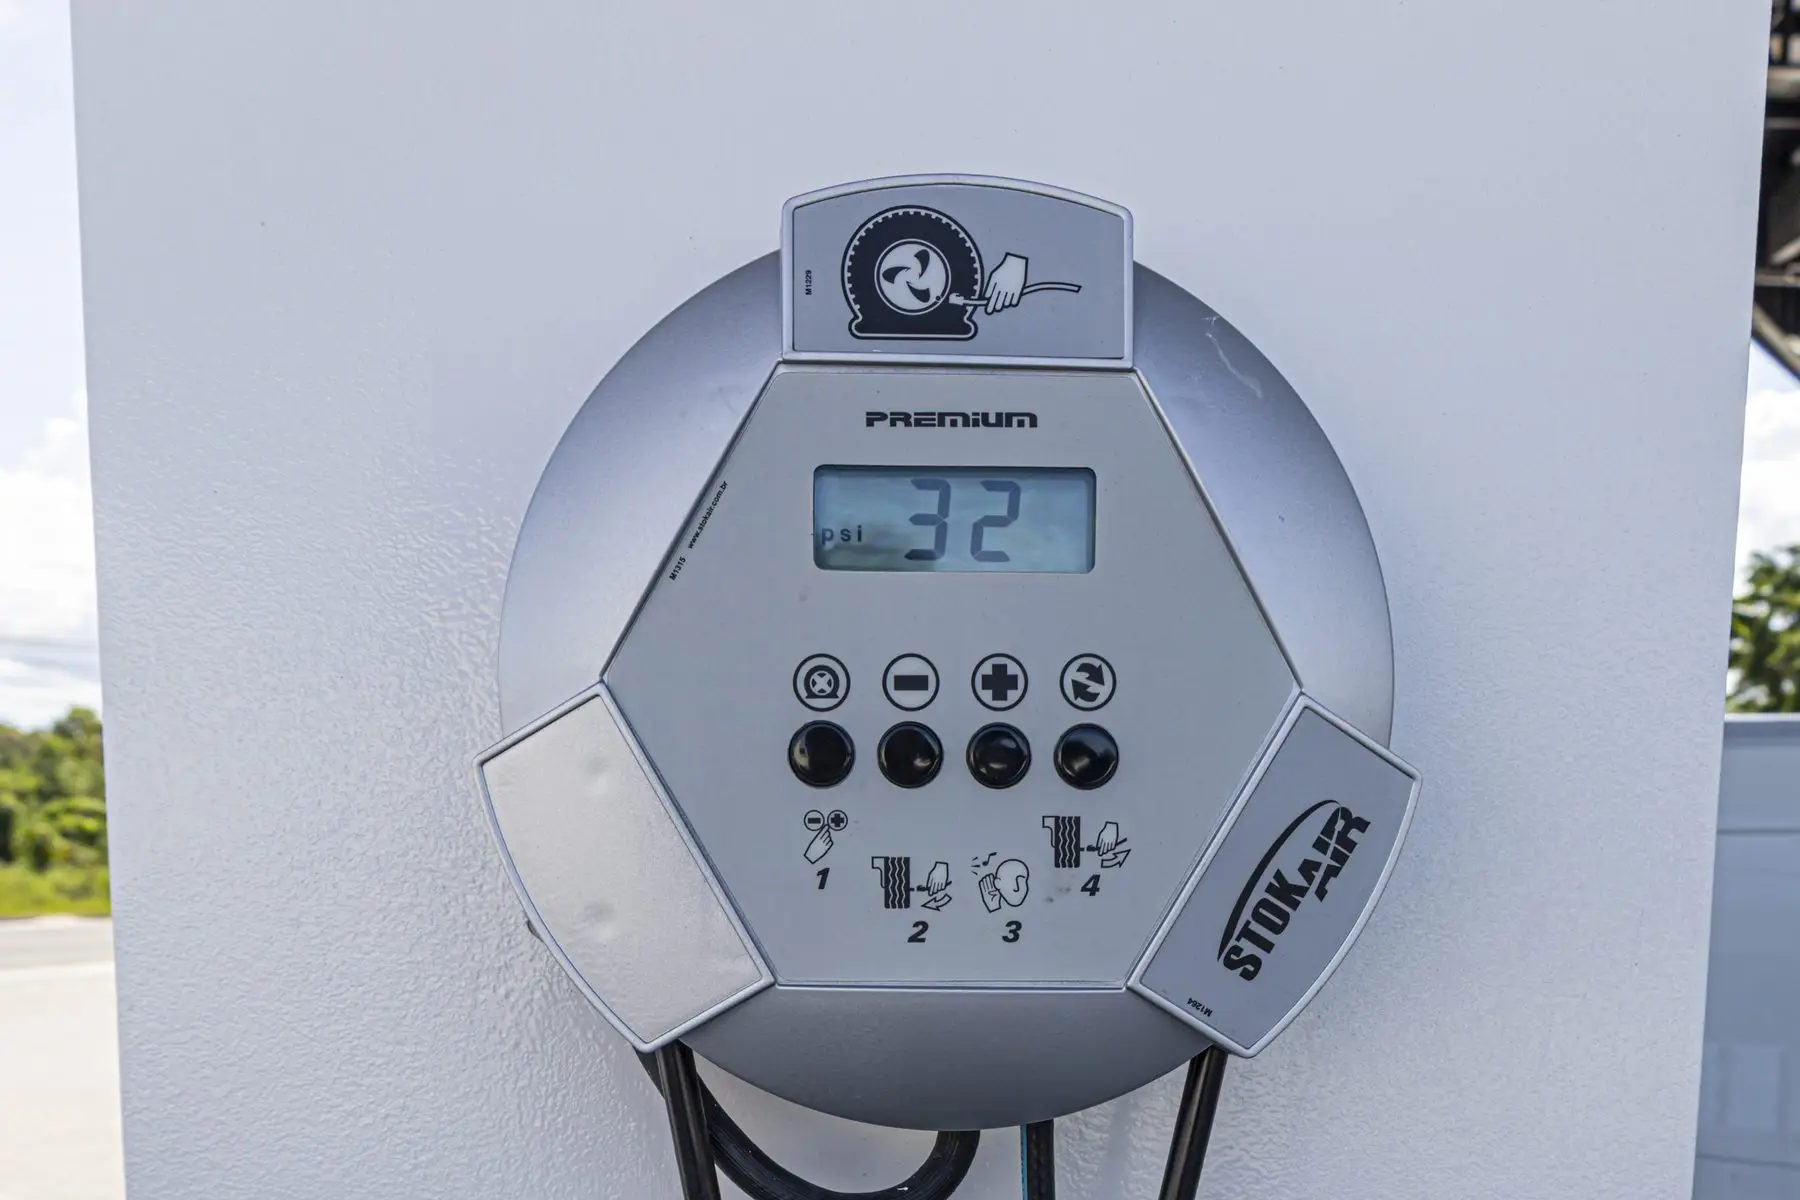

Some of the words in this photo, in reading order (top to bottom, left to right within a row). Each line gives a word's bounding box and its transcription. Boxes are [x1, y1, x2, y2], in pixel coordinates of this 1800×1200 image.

[669, 556, 686, 580] M1315
[688, 480, 728, 549] www.stokair.com.br
[904, 478, 1021, 562] 32
[821, 525, 863, 546] psi
[815, 868, 830, 890] 1
[1080, 874, 1101, 896] 4
[1223, 806, 1371, 982] STOKAIR
[907, 921, 929, 943] 2
[1002, 921, 1022, 943] 3
